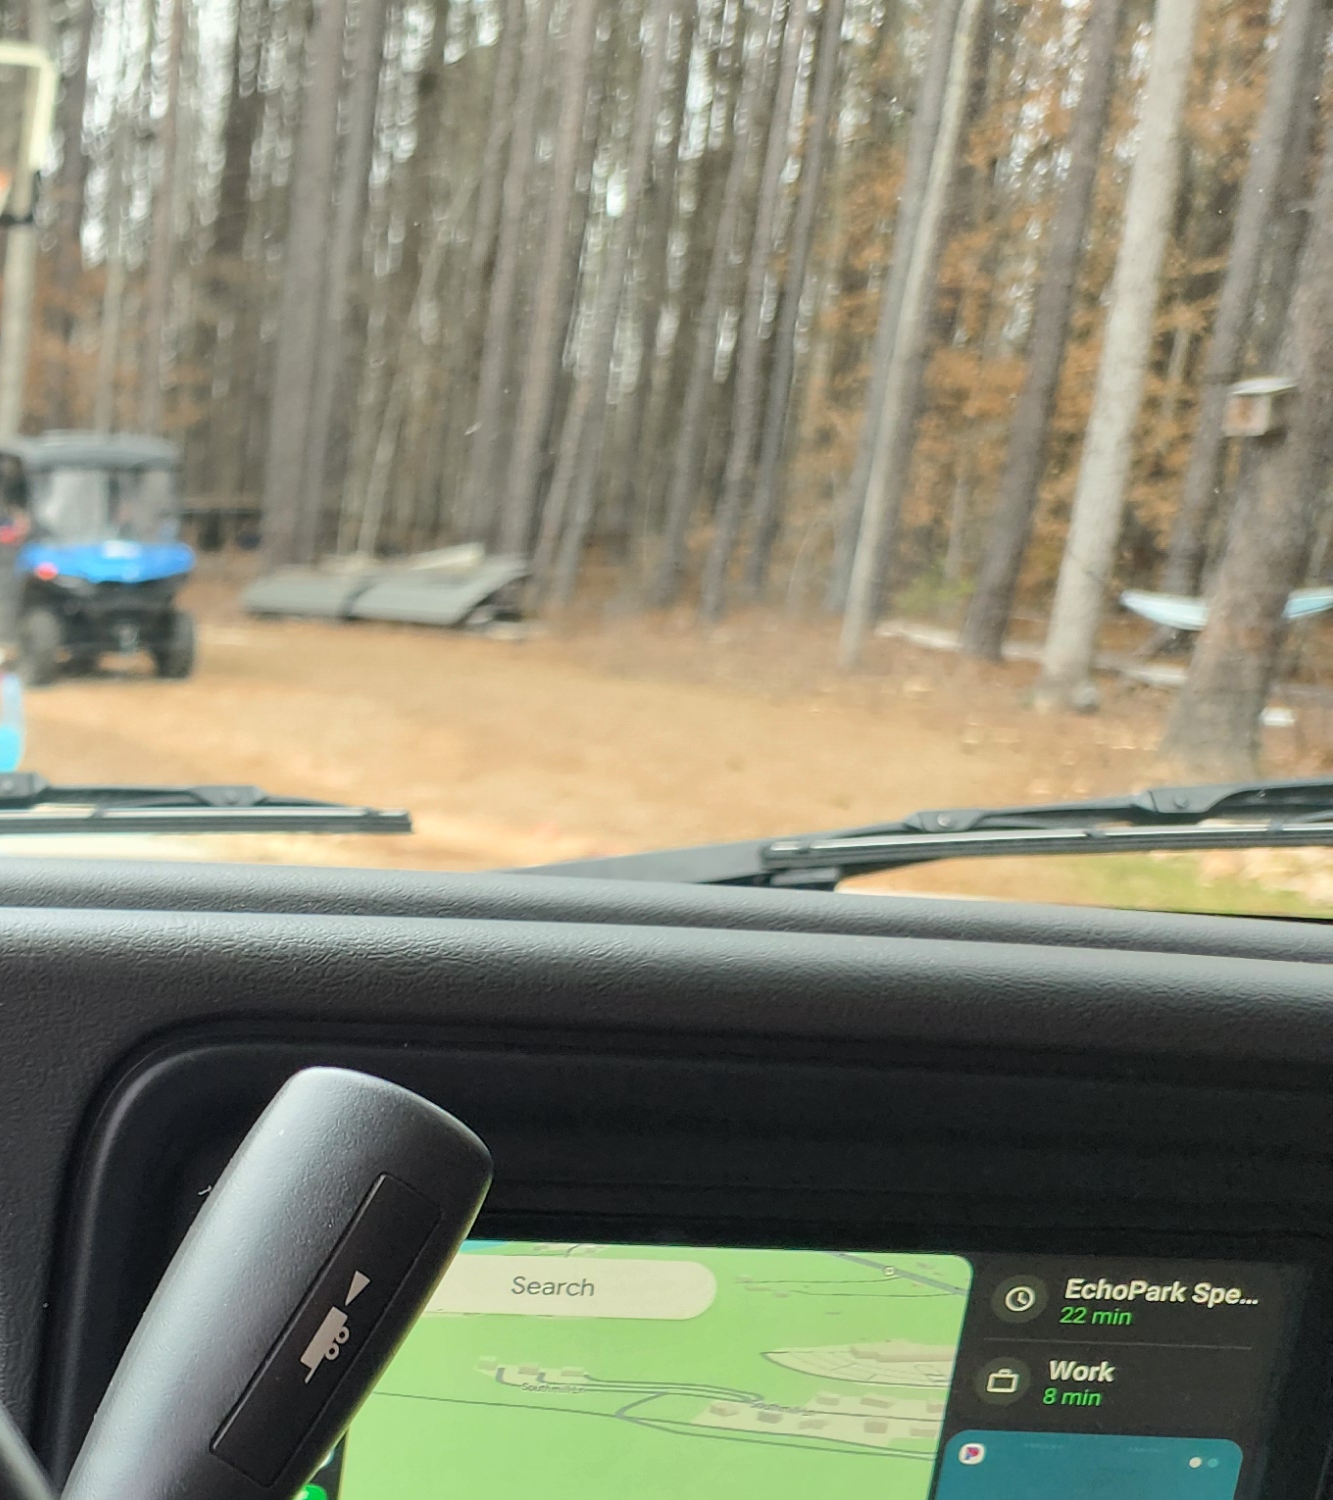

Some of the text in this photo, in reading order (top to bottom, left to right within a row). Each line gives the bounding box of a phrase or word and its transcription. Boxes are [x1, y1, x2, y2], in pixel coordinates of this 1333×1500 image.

[511, 1276, 595, 1298] Search
[1065, 1278, 1186, 1302] EchoPark
[1060, 1307, 1132, 1325] 22 min
[1049, 1360, 1115, 1383] Work
[1043, 1387, 1101, 1406] 8 min
